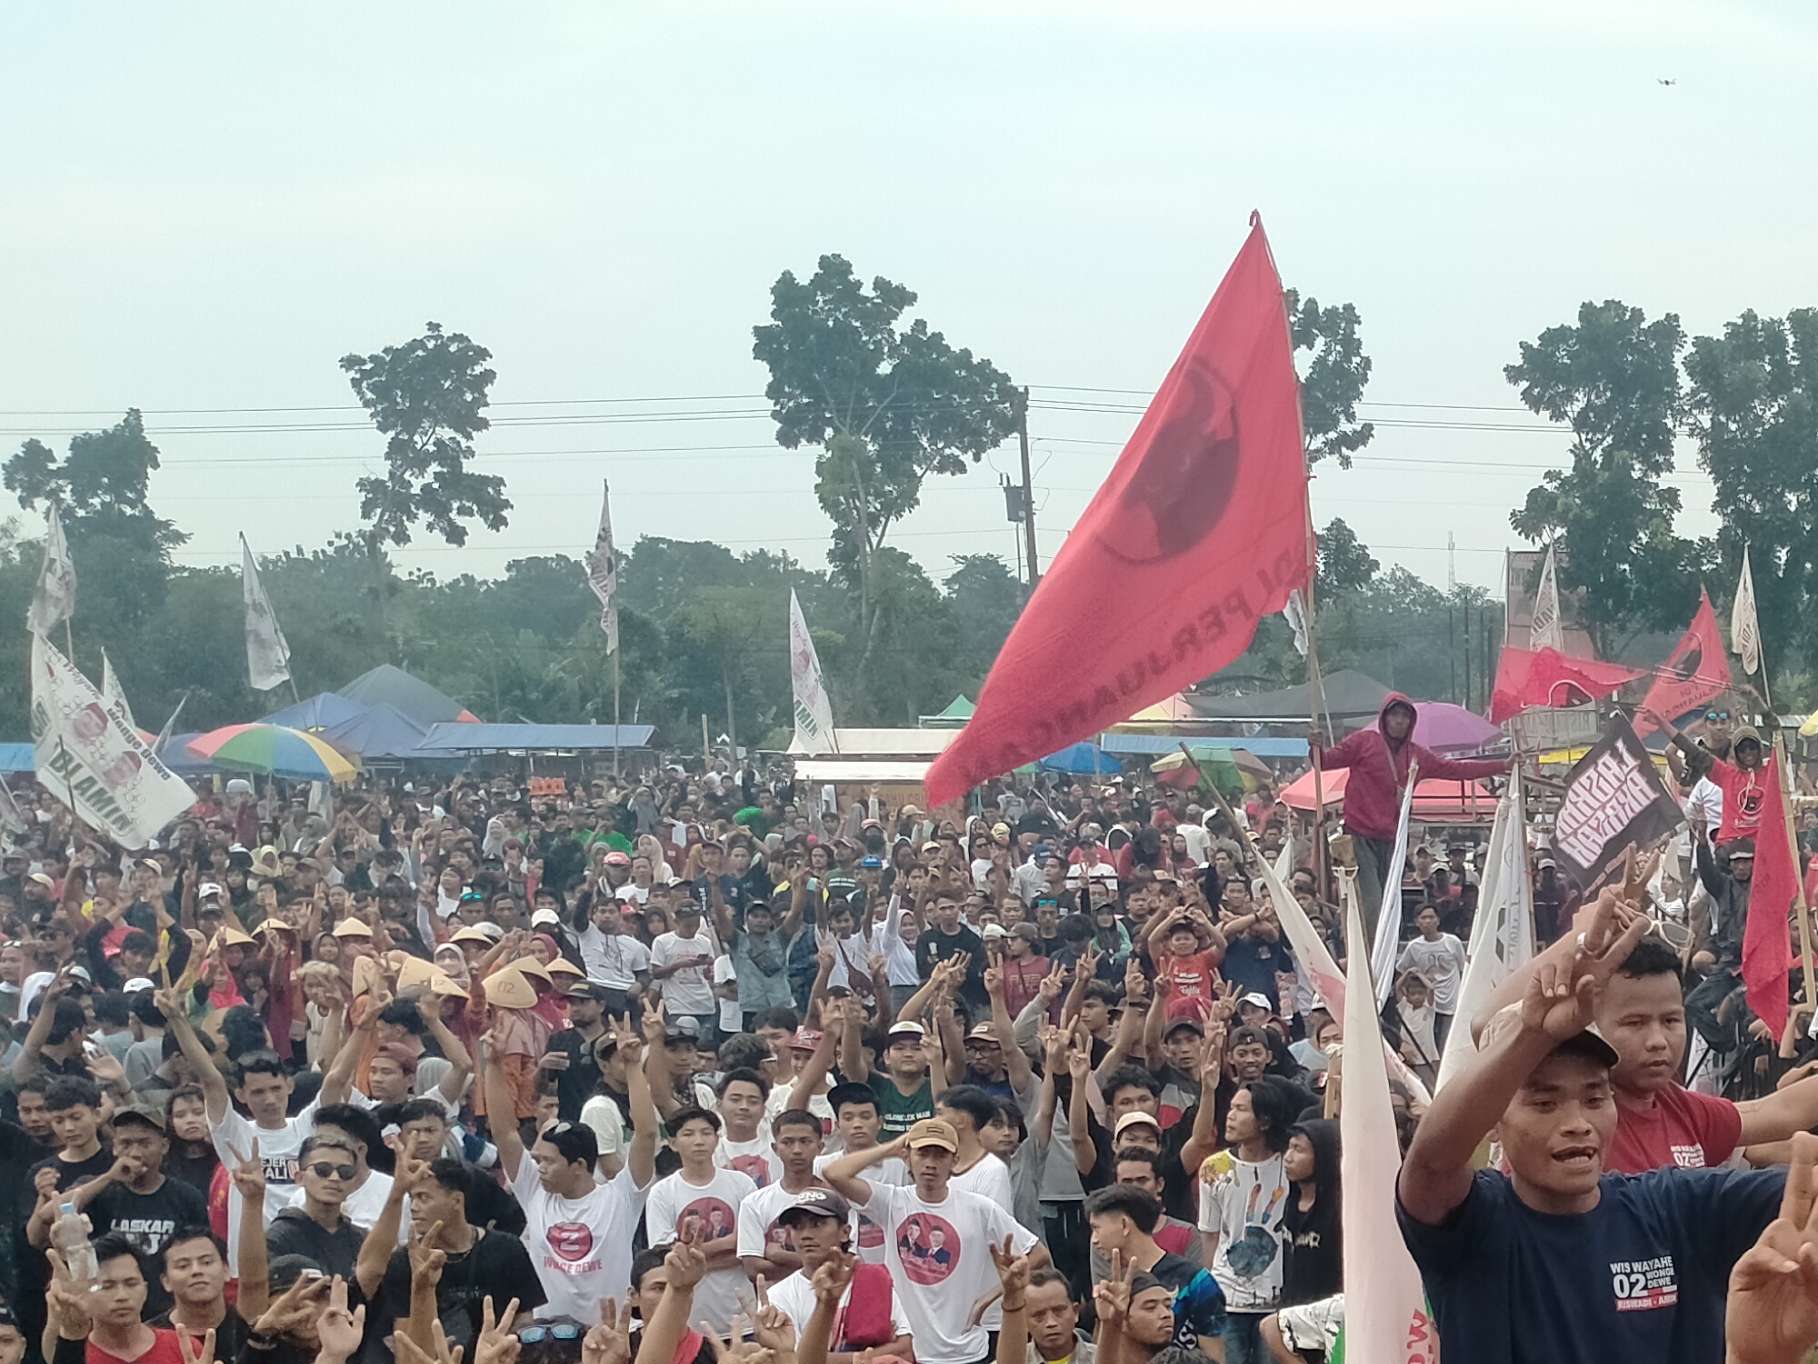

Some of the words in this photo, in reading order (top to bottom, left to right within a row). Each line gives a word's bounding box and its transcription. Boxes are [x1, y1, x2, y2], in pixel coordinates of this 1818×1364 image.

[1610, 1262, 1631, 1275] WIS
[1632, 1255, 1673, 1273] WAYAHE
[1613, 1273, 1648, 1299] 02
[1647, 1276, 1671, 1288] DEWE
